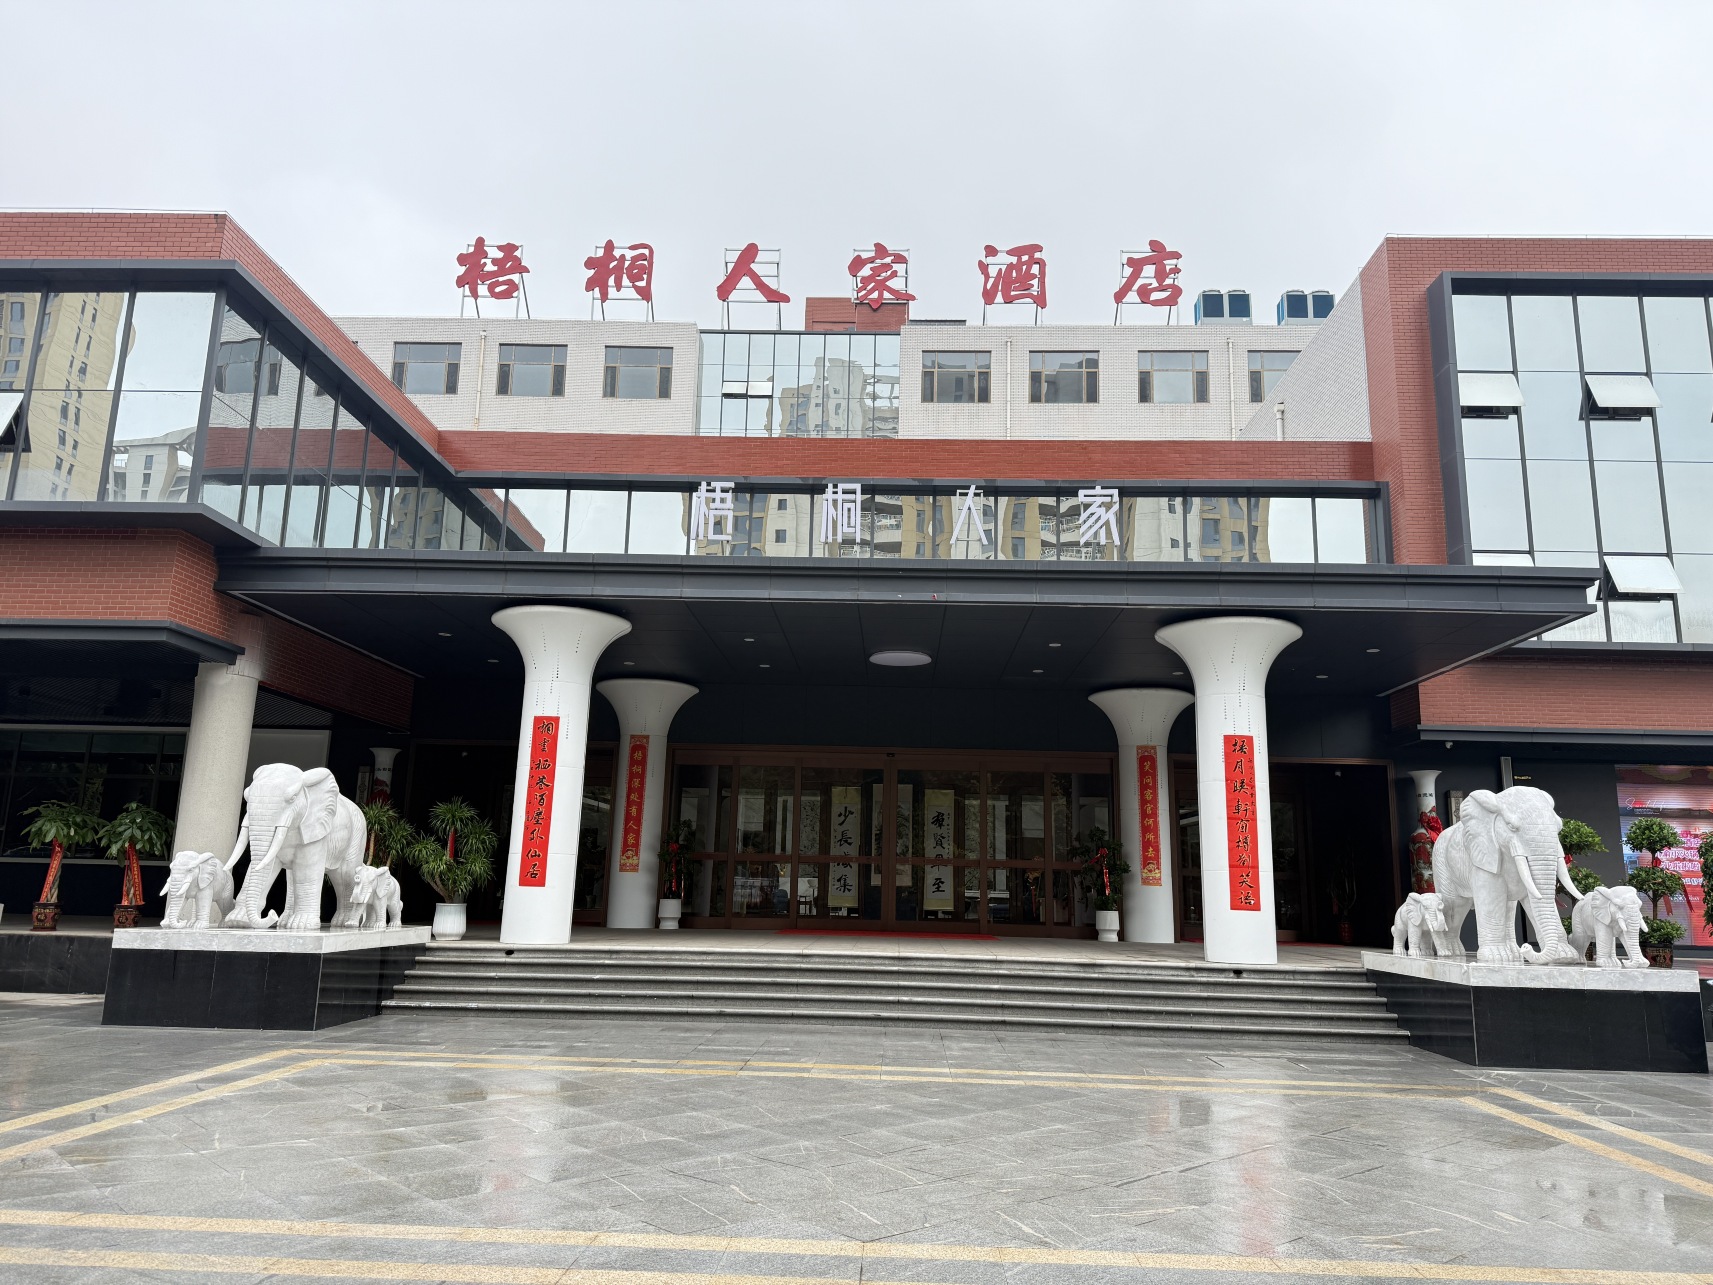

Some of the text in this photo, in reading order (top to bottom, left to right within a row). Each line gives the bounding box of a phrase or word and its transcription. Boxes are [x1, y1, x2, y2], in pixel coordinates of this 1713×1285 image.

[456, 236, 1183, 310] 梧桐人家酒店
[691, 481, 1120, 546] 梧桐人家
